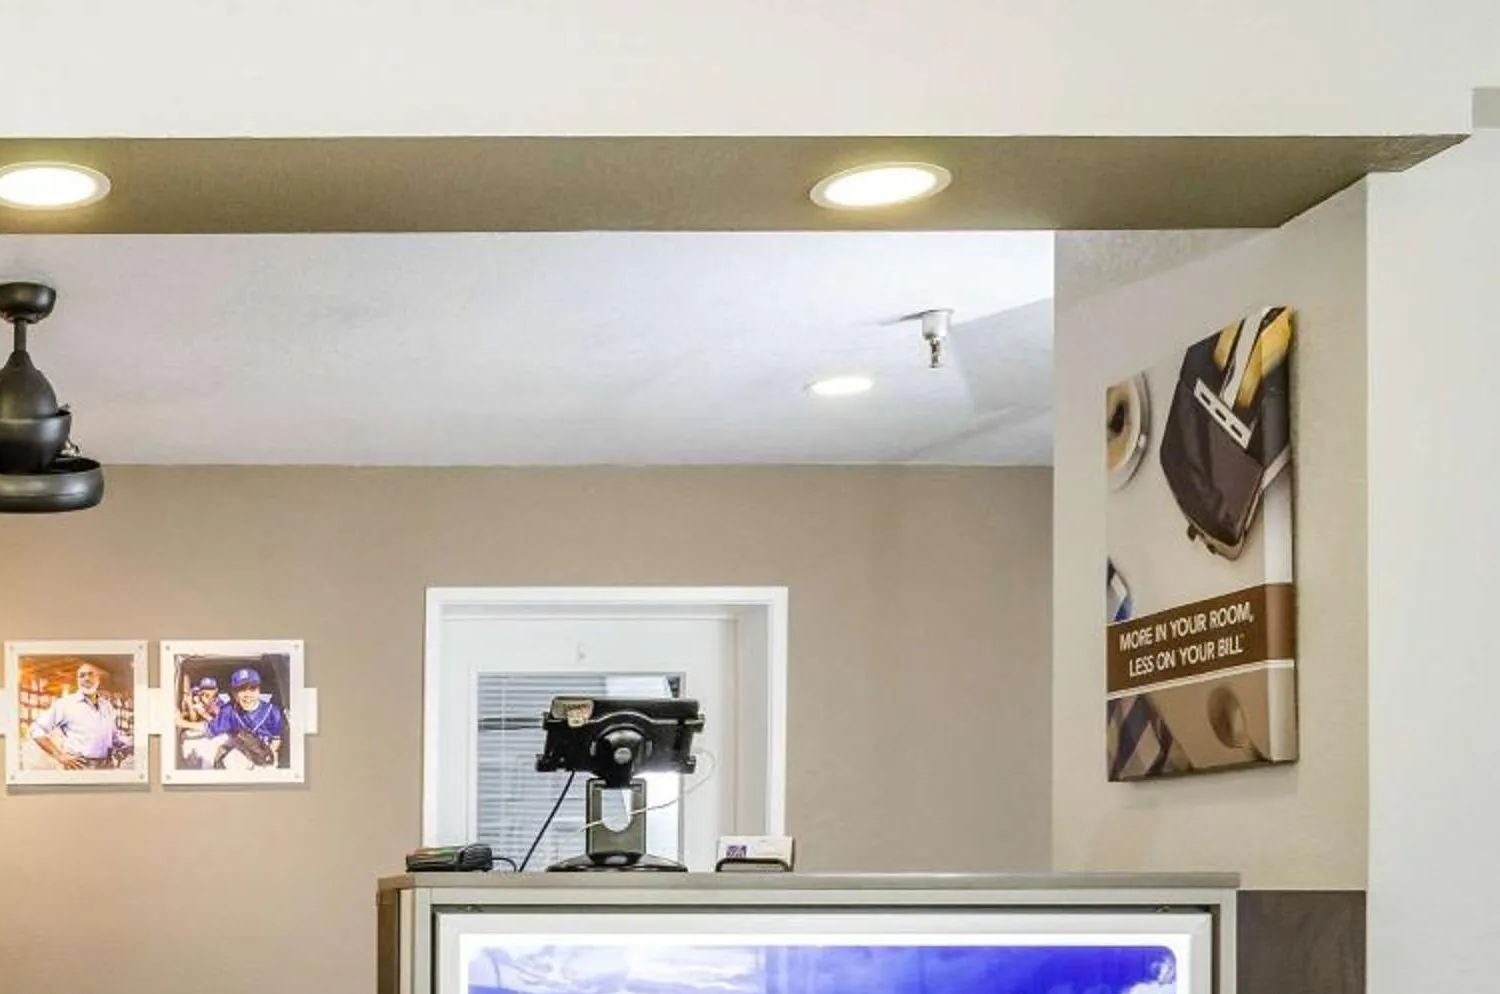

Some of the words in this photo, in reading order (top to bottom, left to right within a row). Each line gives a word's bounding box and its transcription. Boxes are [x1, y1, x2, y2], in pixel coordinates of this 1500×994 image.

[1119, 624, 1153, 651] MORE
[1155, 623, 1167, 643] IN
[1169, 613, 1207, 638] YOUR
[1209, 601, 1255, 629] ROOM,
[1129, 654, 1155, 678] LESS
[1156, 650, 1176, 671] ON
[1179, 640, 1215, 666] YOUR
